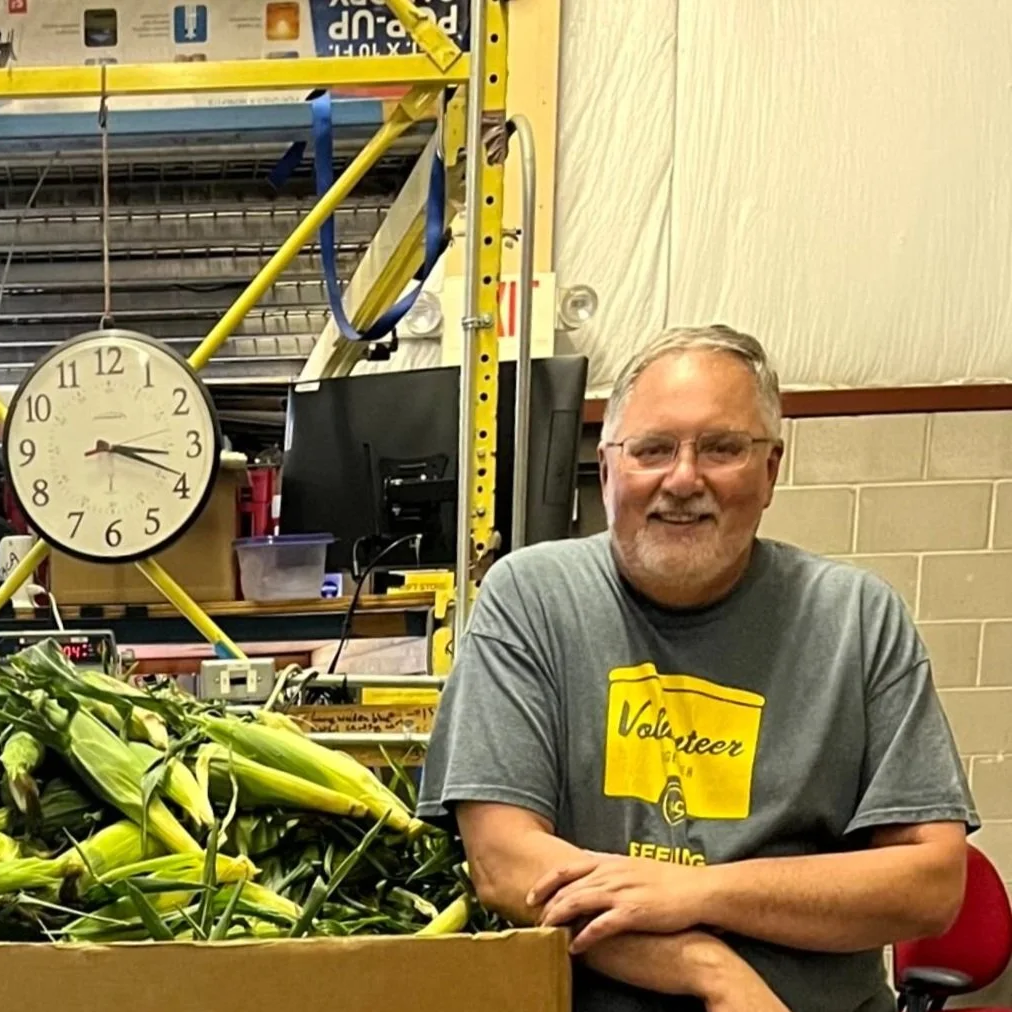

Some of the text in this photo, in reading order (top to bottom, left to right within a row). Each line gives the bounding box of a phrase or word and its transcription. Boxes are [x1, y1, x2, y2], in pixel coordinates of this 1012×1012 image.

[56, 361, 80, 389] 11
[93, 346, 124, 376] 12
[143, 360, 155, 389] 1
[26, 393, 51, 423] 10
[172, 388, 189, 416] 2
[19, 439, 36, 467] 9
[186, 430, 202, 458] 3
[32, 479, 49, 507] 8
[172, 472, 190, 500] 4
[67, 511, 84, 539] 7
[105, 519, 122, 548] 6
[144, 508, 160, 535] 5
[617, 699, 746, 758] Volunteer
